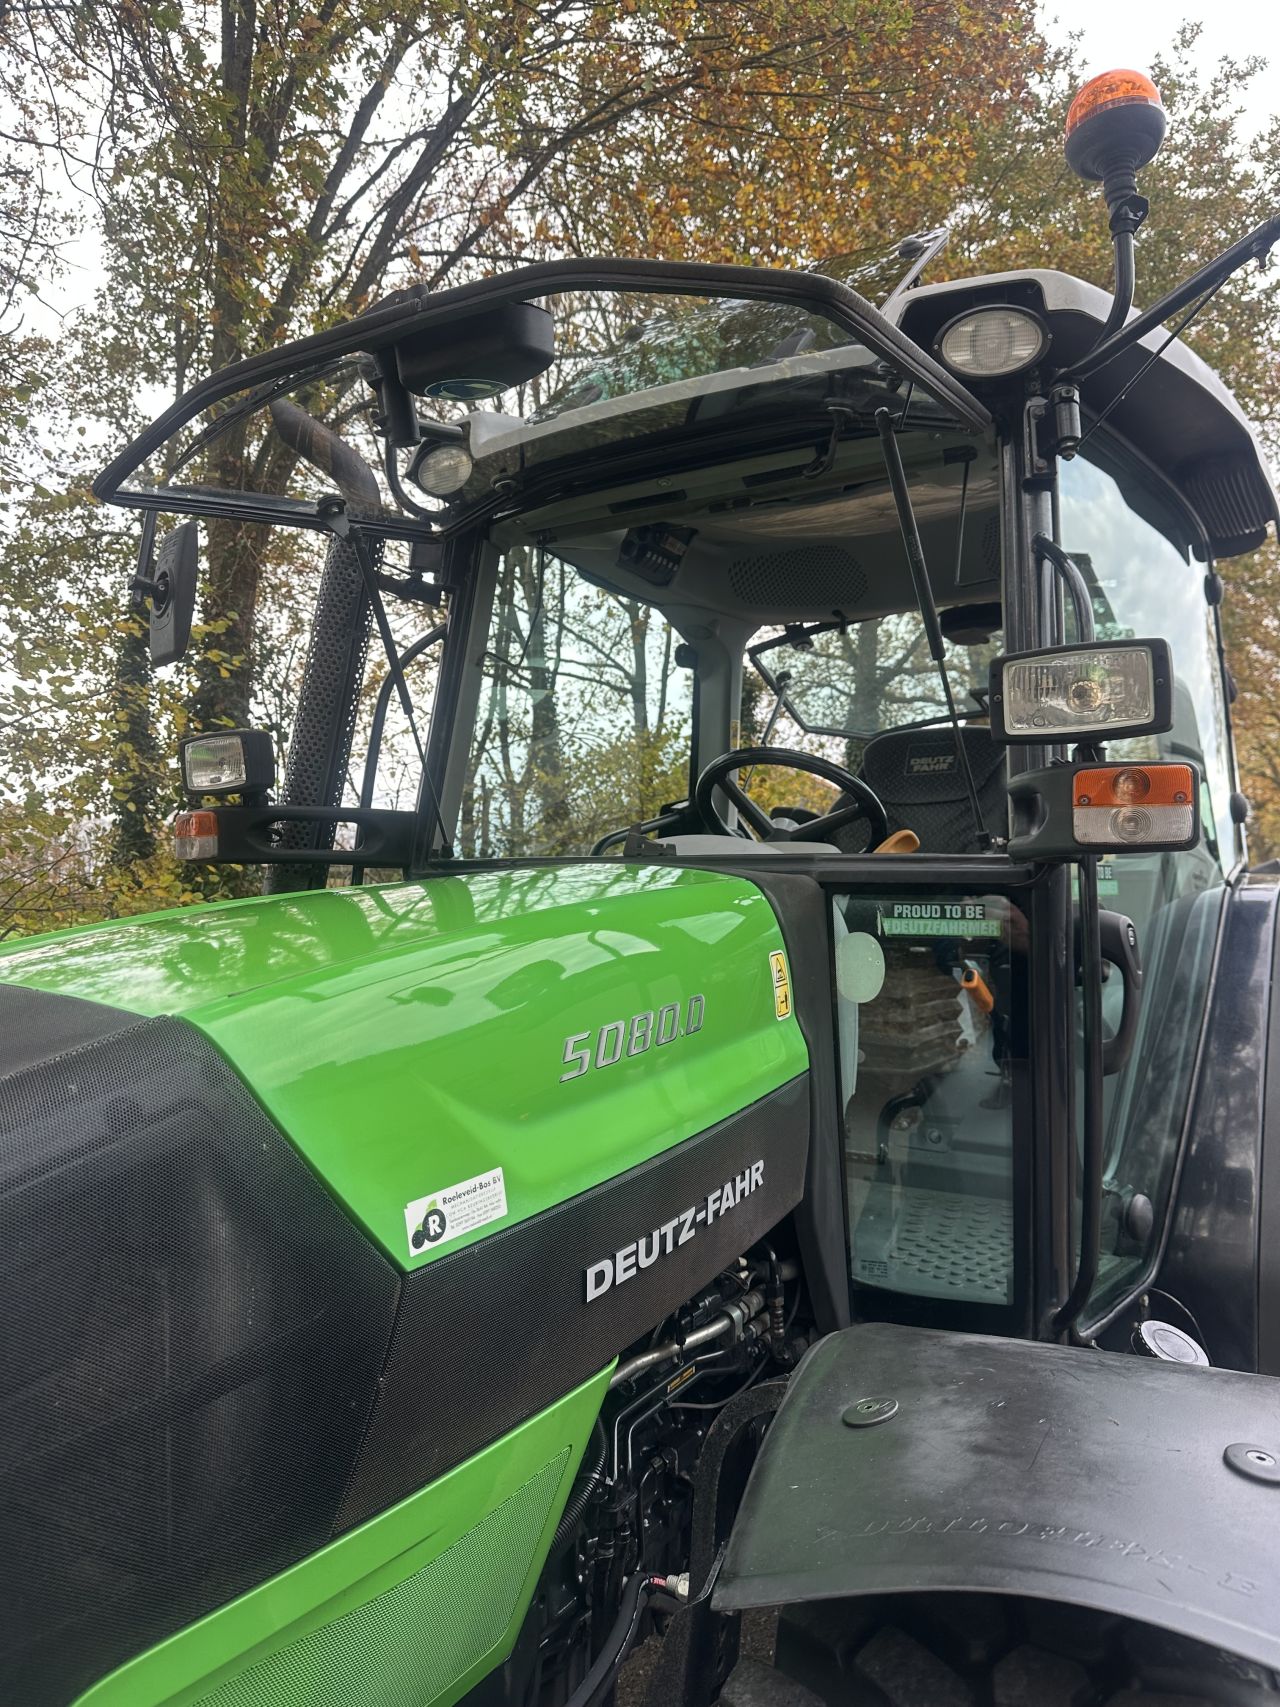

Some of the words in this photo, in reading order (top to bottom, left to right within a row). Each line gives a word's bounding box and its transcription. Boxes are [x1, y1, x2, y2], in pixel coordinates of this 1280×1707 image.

[911, 755, 954, 765] DEUTZ
[913, 763, 949, 772] FAHR
[893, 904, 940, 918] PROUD
[944, 905, 961, 918] TO
[965, 905, 984, 919] BE
[428, 1214, 443, 1237] R
[586, 1159, 764, 1303] DEUTZ-FAHR
